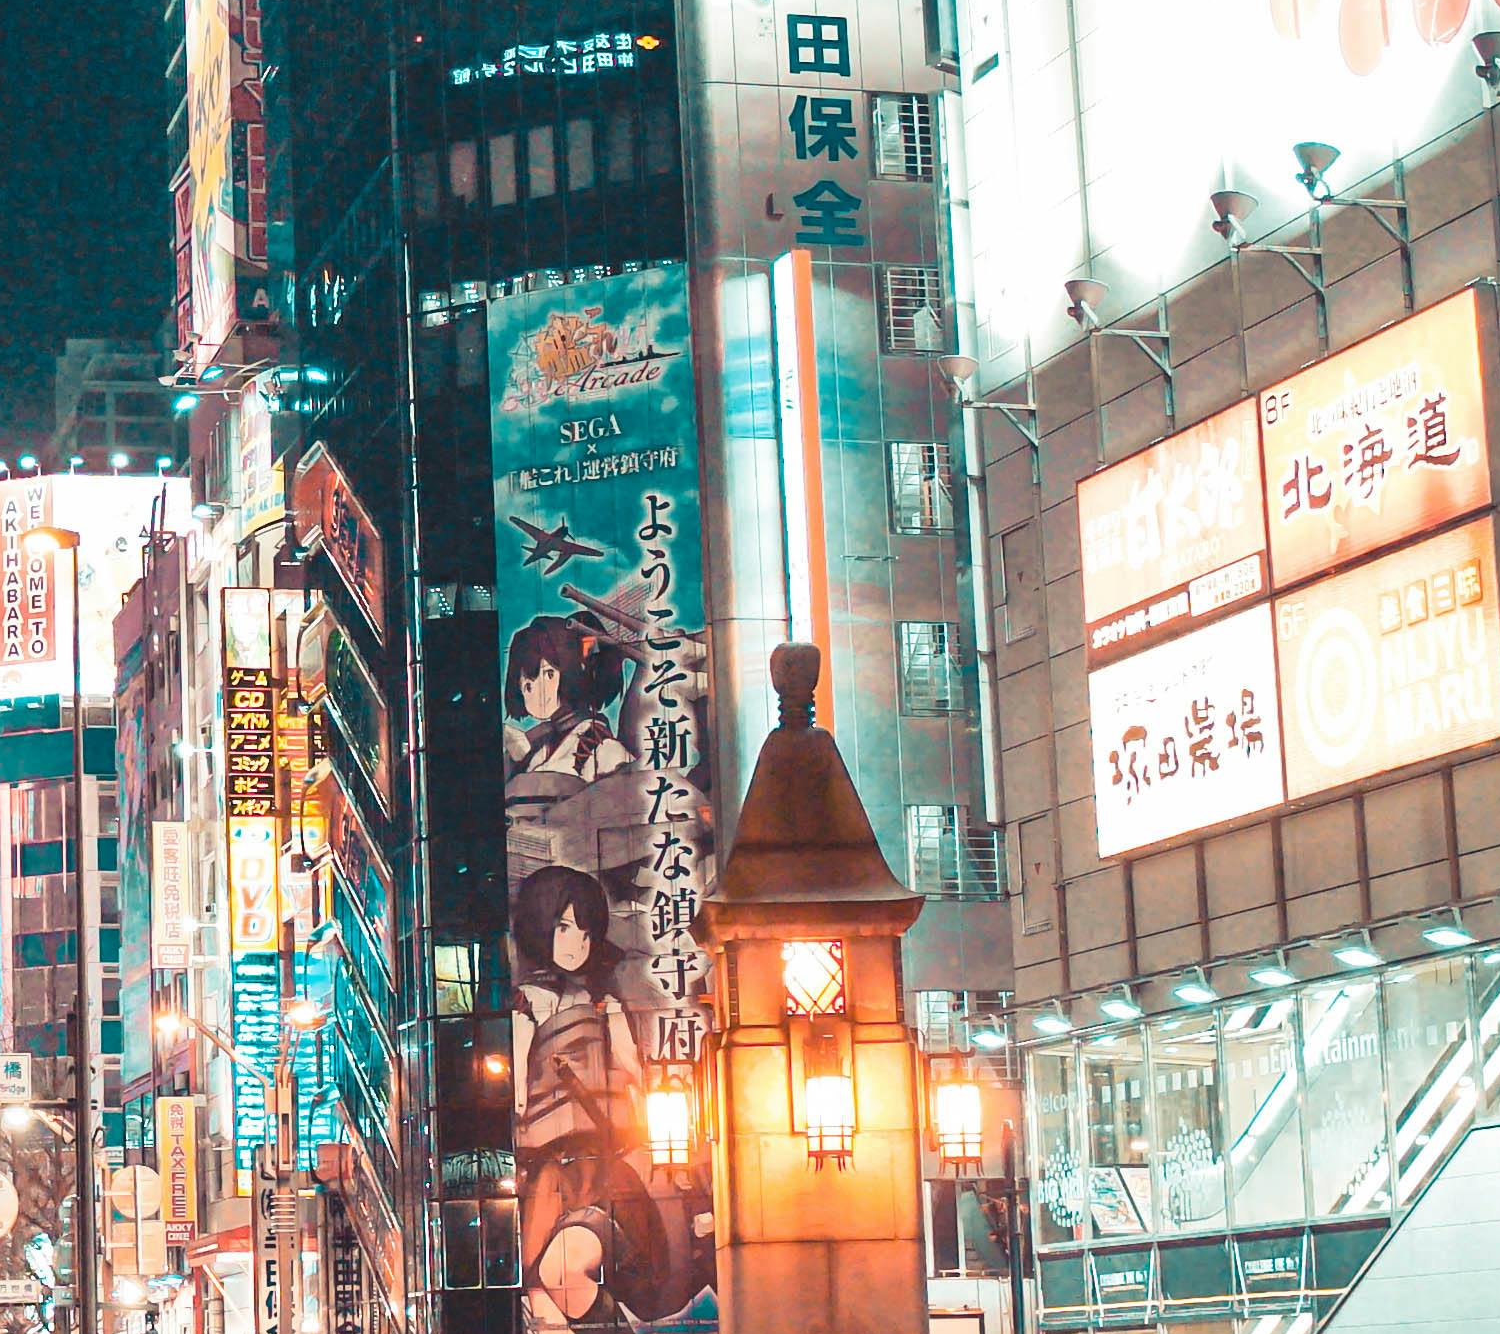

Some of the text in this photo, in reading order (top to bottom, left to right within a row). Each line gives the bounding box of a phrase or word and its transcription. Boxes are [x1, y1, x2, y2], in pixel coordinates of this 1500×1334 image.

[554, 363, 661, 401] Arcade
[1265, 392, 1290, 425] 8F
[558, 413, 622, 445] SEGA
[507, 446, 678, 492] 「艦これ」運営鎮守府
[1282, 392, 1461, 520] 北海道
[5, 500, 24, 657] AKIHABARA
[27, 487, 44, 654] WEOME TO
[230, 669, 268, 687] ゲーム
[234, 690, 265, 708] CD
[1382, 663, 1493, 746] MARU
[230, 712, 270, 730] アイドル
[230, 734, 272, 750] アニメ
[1109, 688, 1266, 805] 塚田農場
[231, 755, 270, 773] コミック
[637, 493, 704, 1063] ようこそ新たな鎮守府
[233, 777, 269, 794] ホビー
[231, 799, 271, 816] フィギュア
[169, 1103, 184, 1130] 免税
[170, 1134, 187, 1218] TAX FREE
